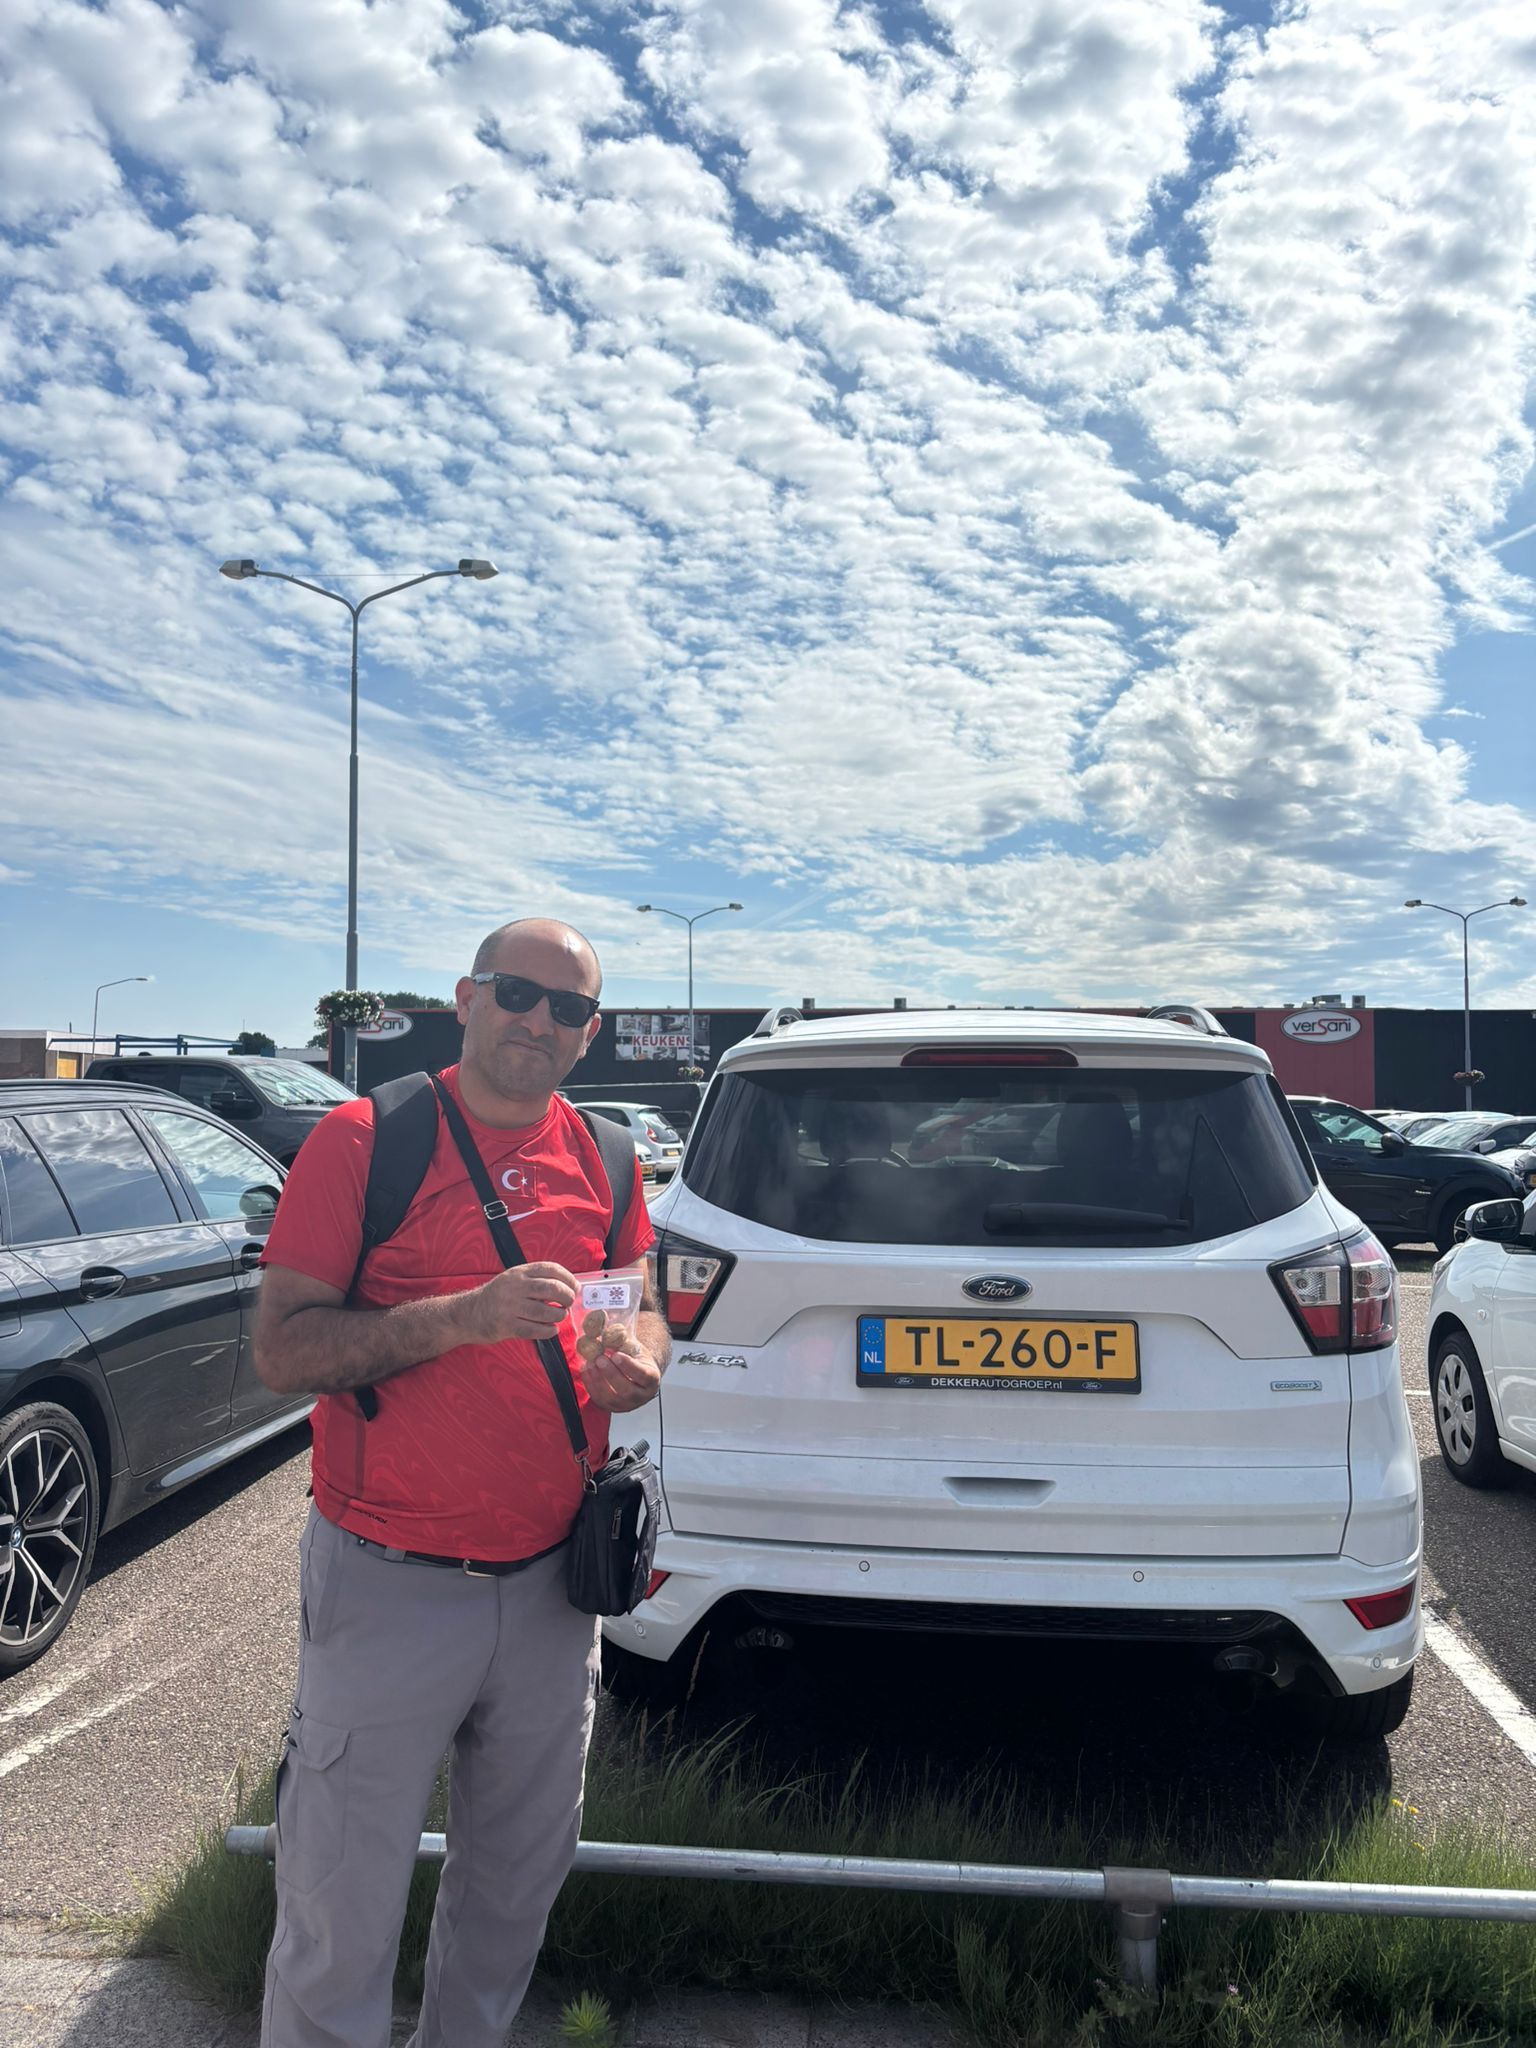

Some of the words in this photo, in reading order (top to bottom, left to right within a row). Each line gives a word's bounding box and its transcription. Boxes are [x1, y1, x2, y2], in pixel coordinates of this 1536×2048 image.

[979, 1280, 1016, 1297] Ford
[905, 1326, 1118, 1370] TL-260-F
[864, 1351, 882, 1364] NL
[931, 1377, 1063, 1390] DEKKERAUTOGROEP.nl
